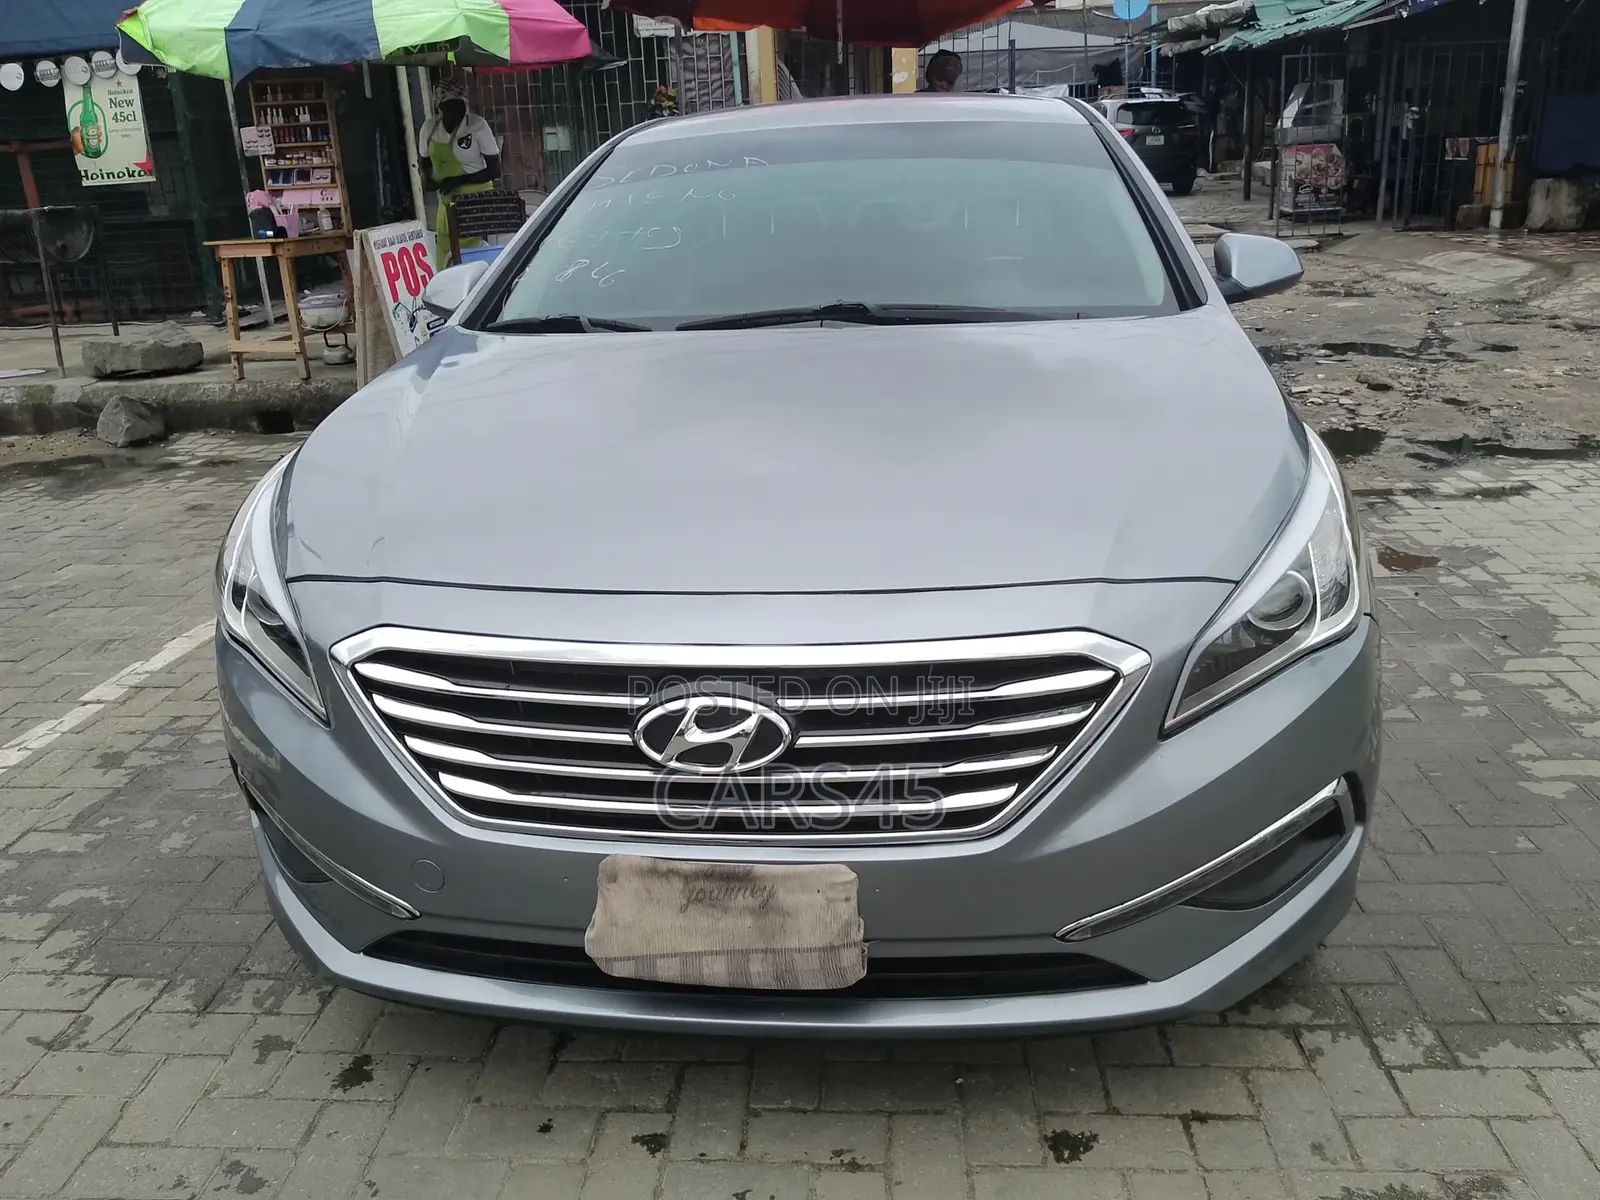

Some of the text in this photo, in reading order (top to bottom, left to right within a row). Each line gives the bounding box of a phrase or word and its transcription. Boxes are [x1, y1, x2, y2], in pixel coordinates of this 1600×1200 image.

[108, 97, 135, 109] New
[111, 110, 138, 123] 45cl
[380, 242, 435, 304] POS
